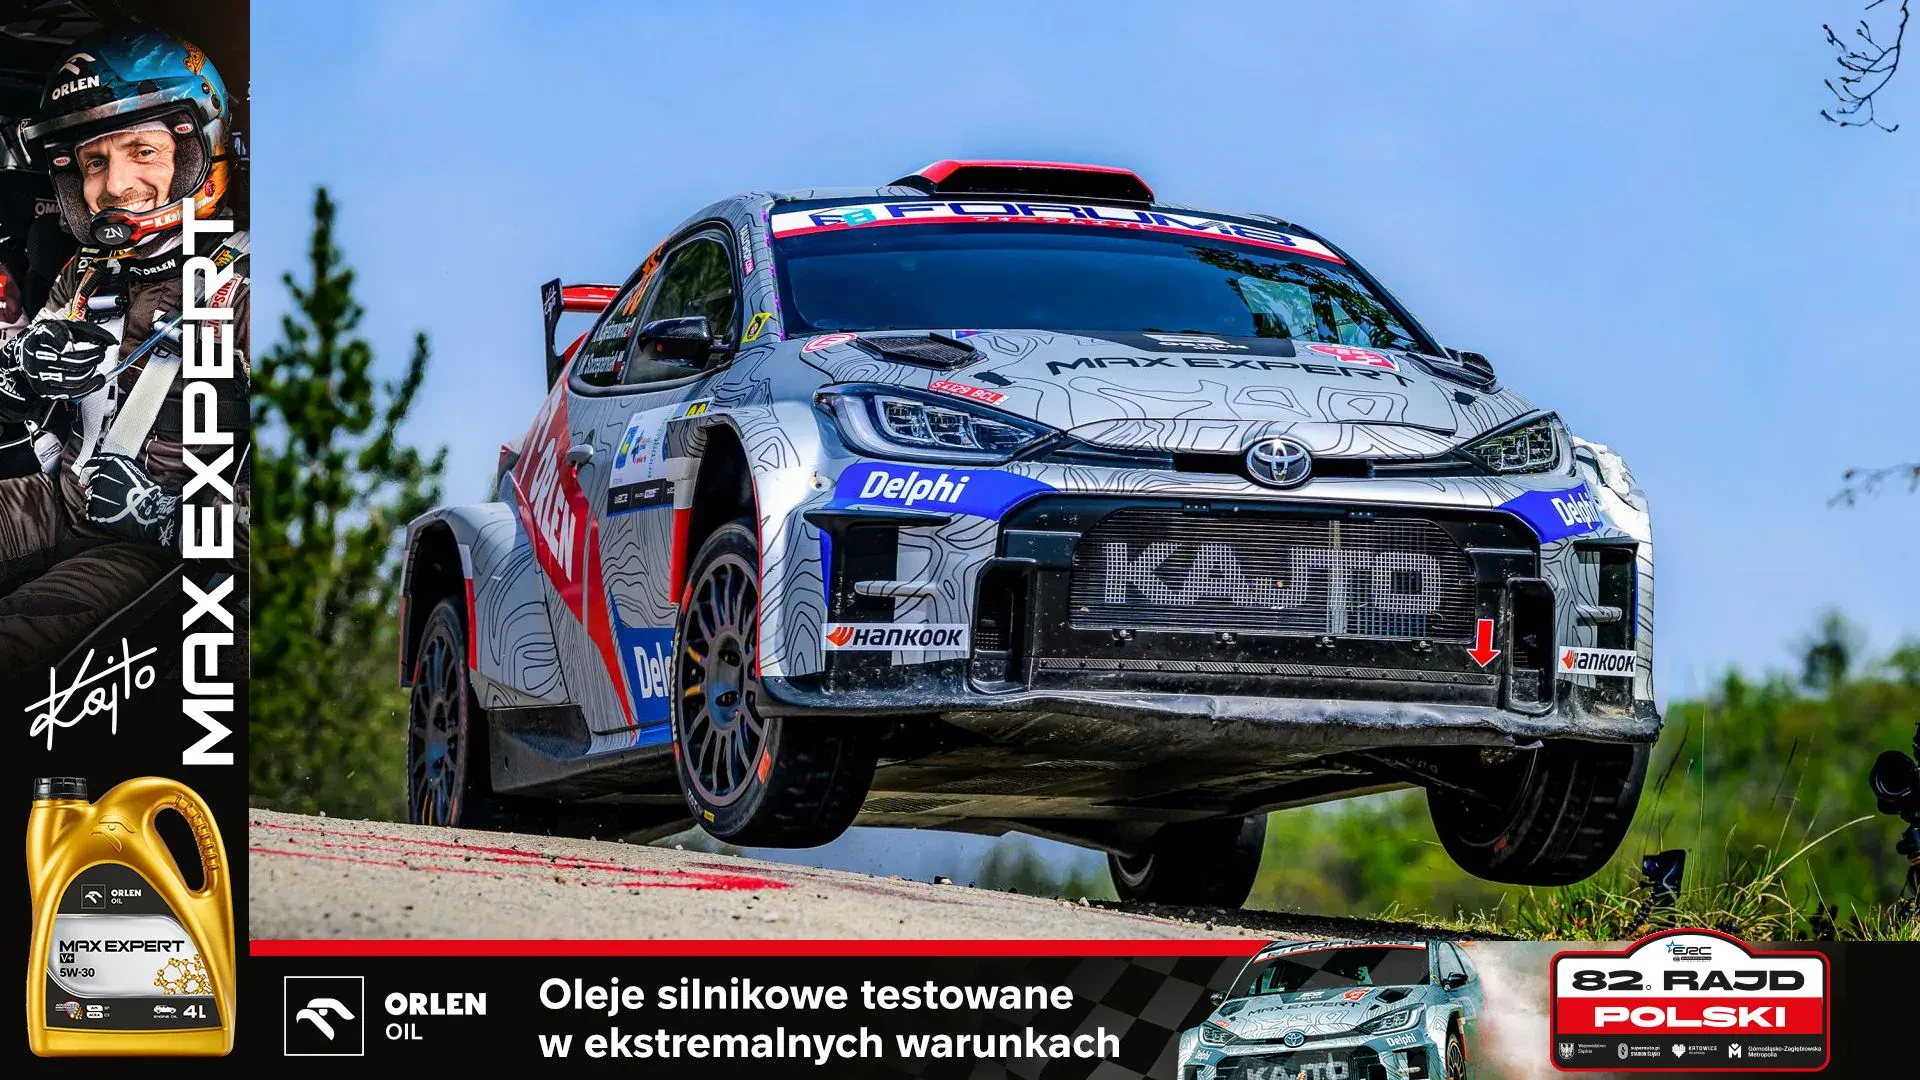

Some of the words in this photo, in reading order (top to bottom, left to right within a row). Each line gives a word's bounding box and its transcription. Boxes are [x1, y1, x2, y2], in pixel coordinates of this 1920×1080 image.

[52, 75, 99, 100] ORLEN
[885, 203, 1297, 247] FORUM8
[143, 259, 177, 275] ORLEN
[1045, 357, 1172, 375] MAX
[1186, 358, 1415, 387] EXPERT
[859, 471, 970, 506] Delphi
[529, 438, 576, 582] ORLEN
[1102, 541, 1443, 614] KAJTO
[111, 889, 141, 897] ORLEN
[60, 941, 101, 952] MAX
[104, 940, 184, 952] EXPERT
[61, 954, 73, 962] V+
[59, 967, 95, 978] 5W-30
[1248, 1005, 1283, 1016] MAX
[1287, 1002, 1360, 1010] EXPERT
[1386, 1033, 1417, 1047] Delphi
